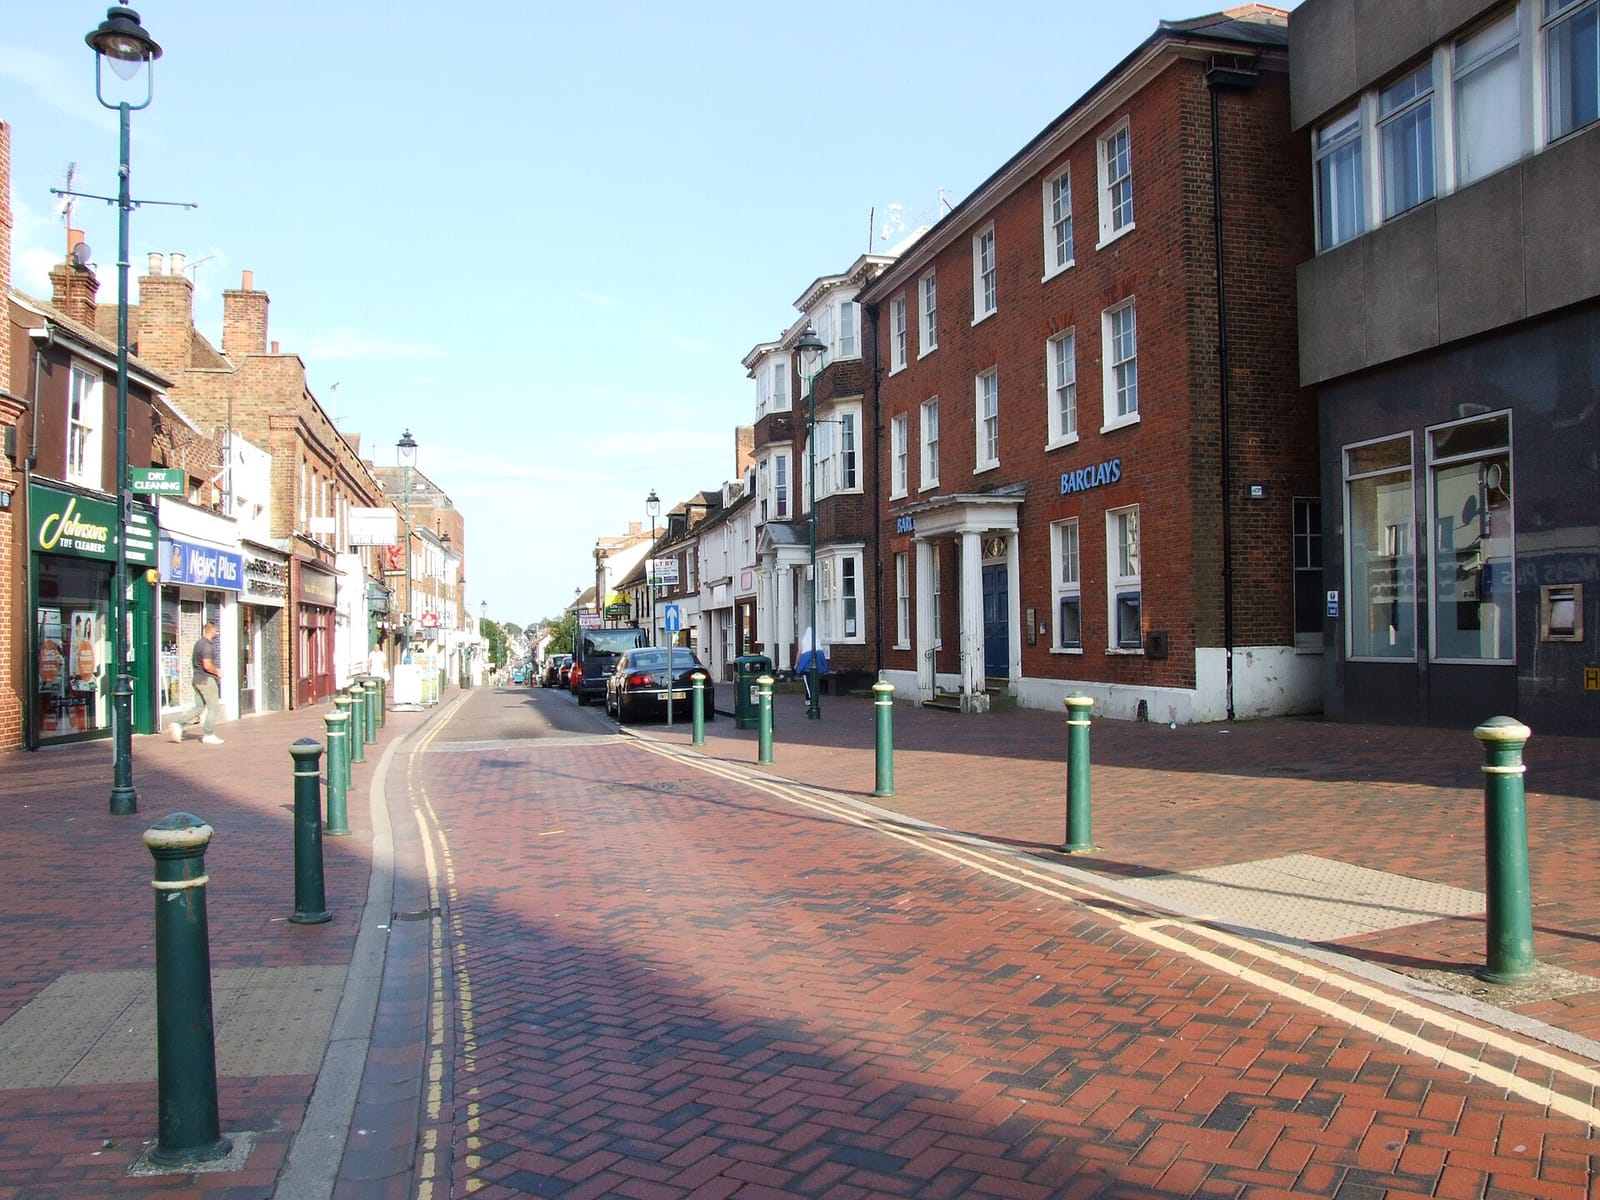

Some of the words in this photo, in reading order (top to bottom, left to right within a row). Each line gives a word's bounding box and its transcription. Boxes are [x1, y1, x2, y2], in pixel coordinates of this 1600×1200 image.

[133, 480, 181, 491] CLEANING
[147, 471, 166, 481] DRY
[1060, 458, 1121, 495] BARCLAYS
[39, 497, 108, 549] Johnsons
[60, 537, 73, 548] THE
[74, 540, 106, 553] CLEANERS
[189, 549, 216, 577] News
[217, 555, 237, 581] Plus
[1586, 668, 1599, 690] H
